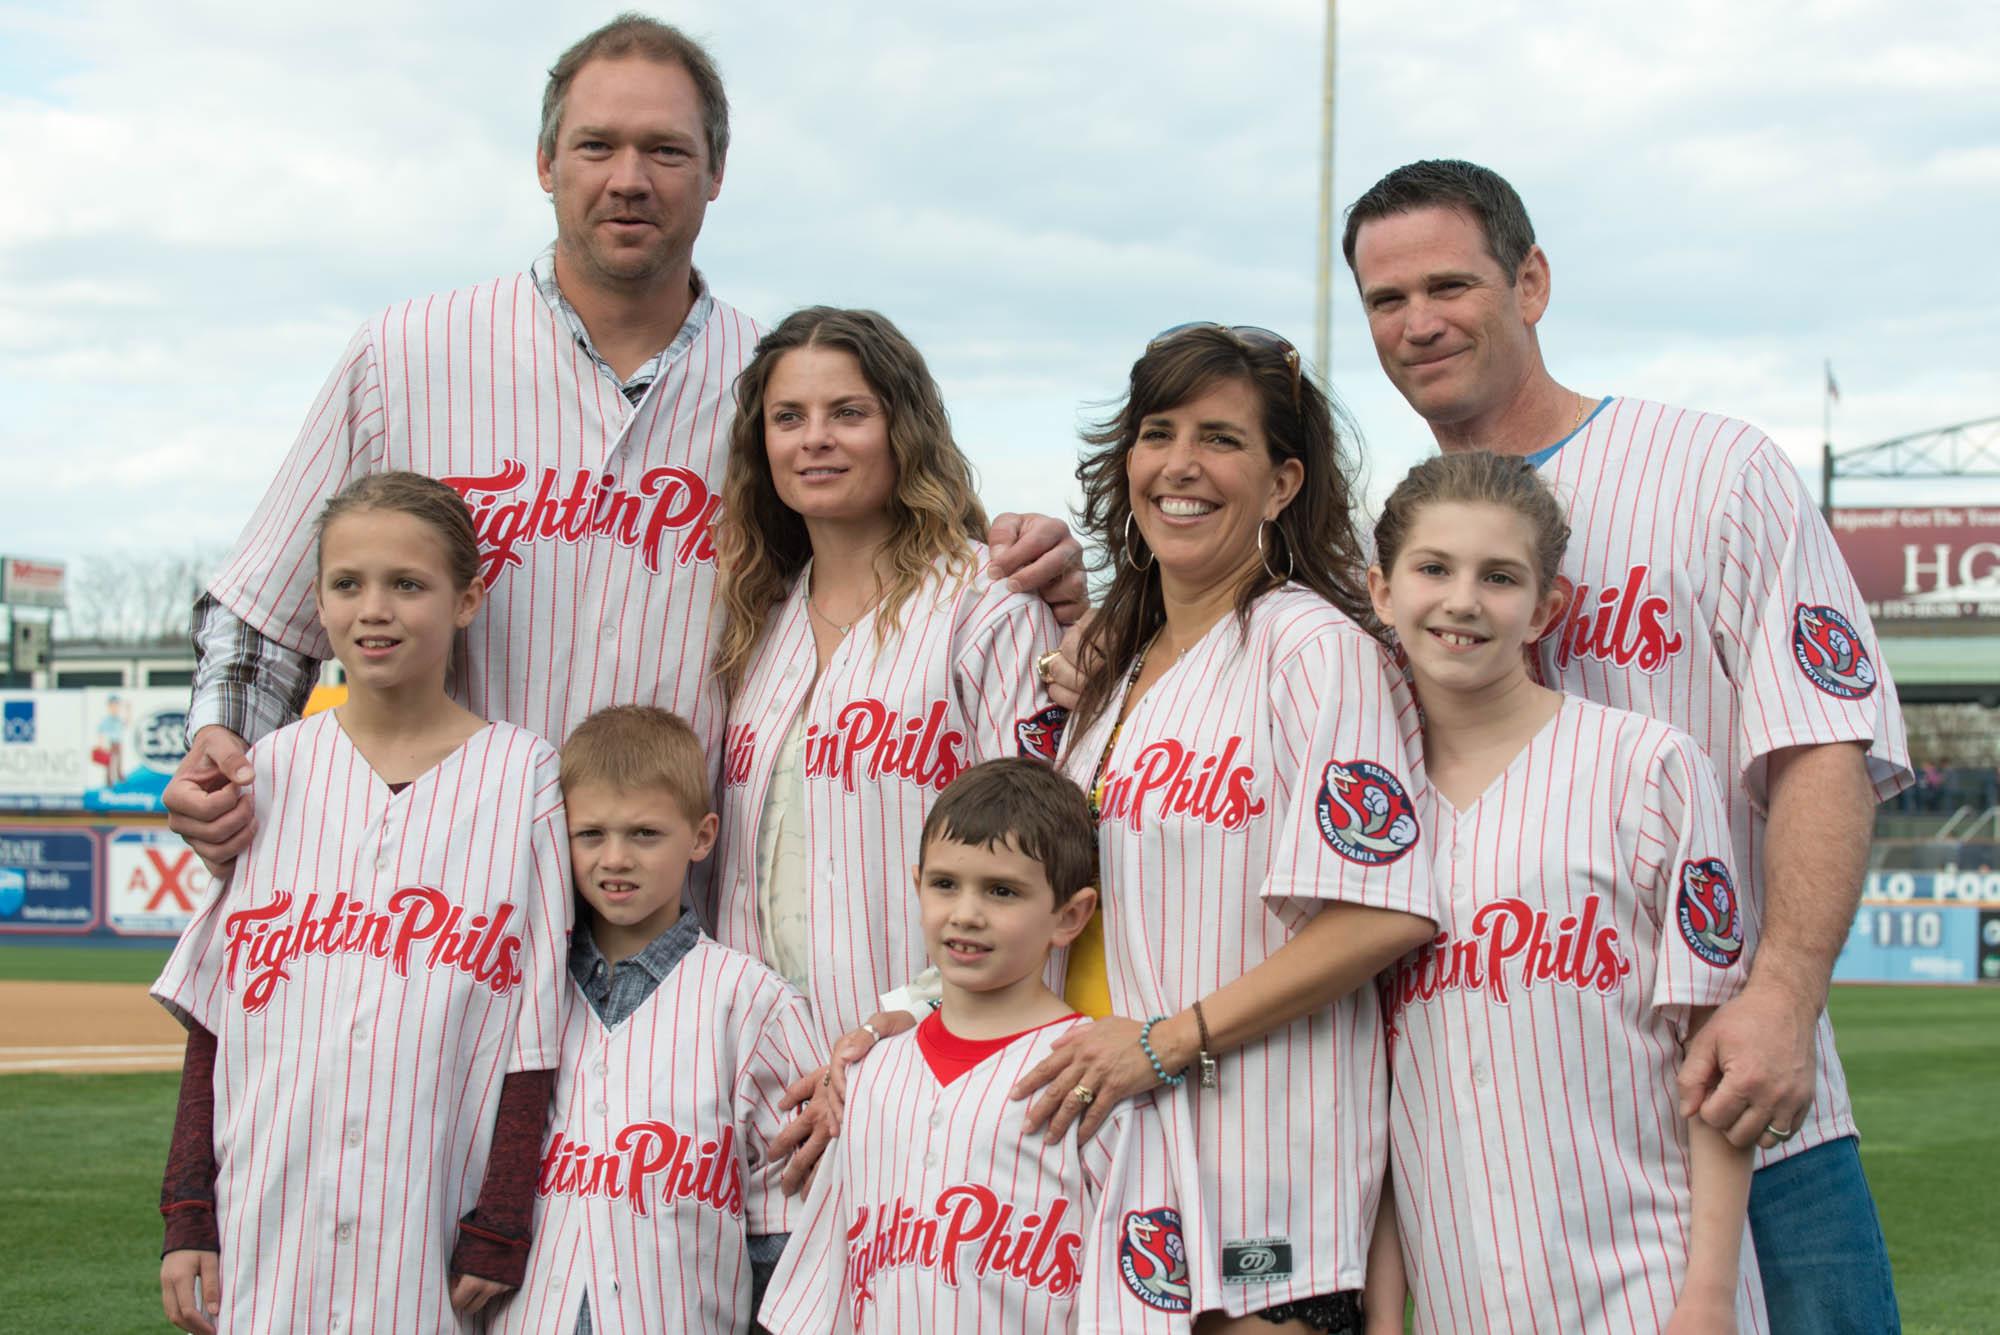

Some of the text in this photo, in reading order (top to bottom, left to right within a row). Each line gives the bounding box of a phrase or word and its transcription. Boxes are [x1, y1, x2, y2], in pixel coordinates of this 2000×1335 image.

[1796, 643, 1853, 697] PENNSYLVANIA
[1131, 735, 1268, 833] Phils
[1363, 764, 1403, 796] READING
[1319, 803, 1377, 862] PENNSYLVANIA
[387, 884, 523, 997] Phils
[1471, 895, 1631, 1006] Phils
[1680, 907, 1729, 964] PENNSYLVANIA
[934, 1182, 1084, 1299] Phils
[1121, 1253, 1185, 1311] PENNSYLVANIA
